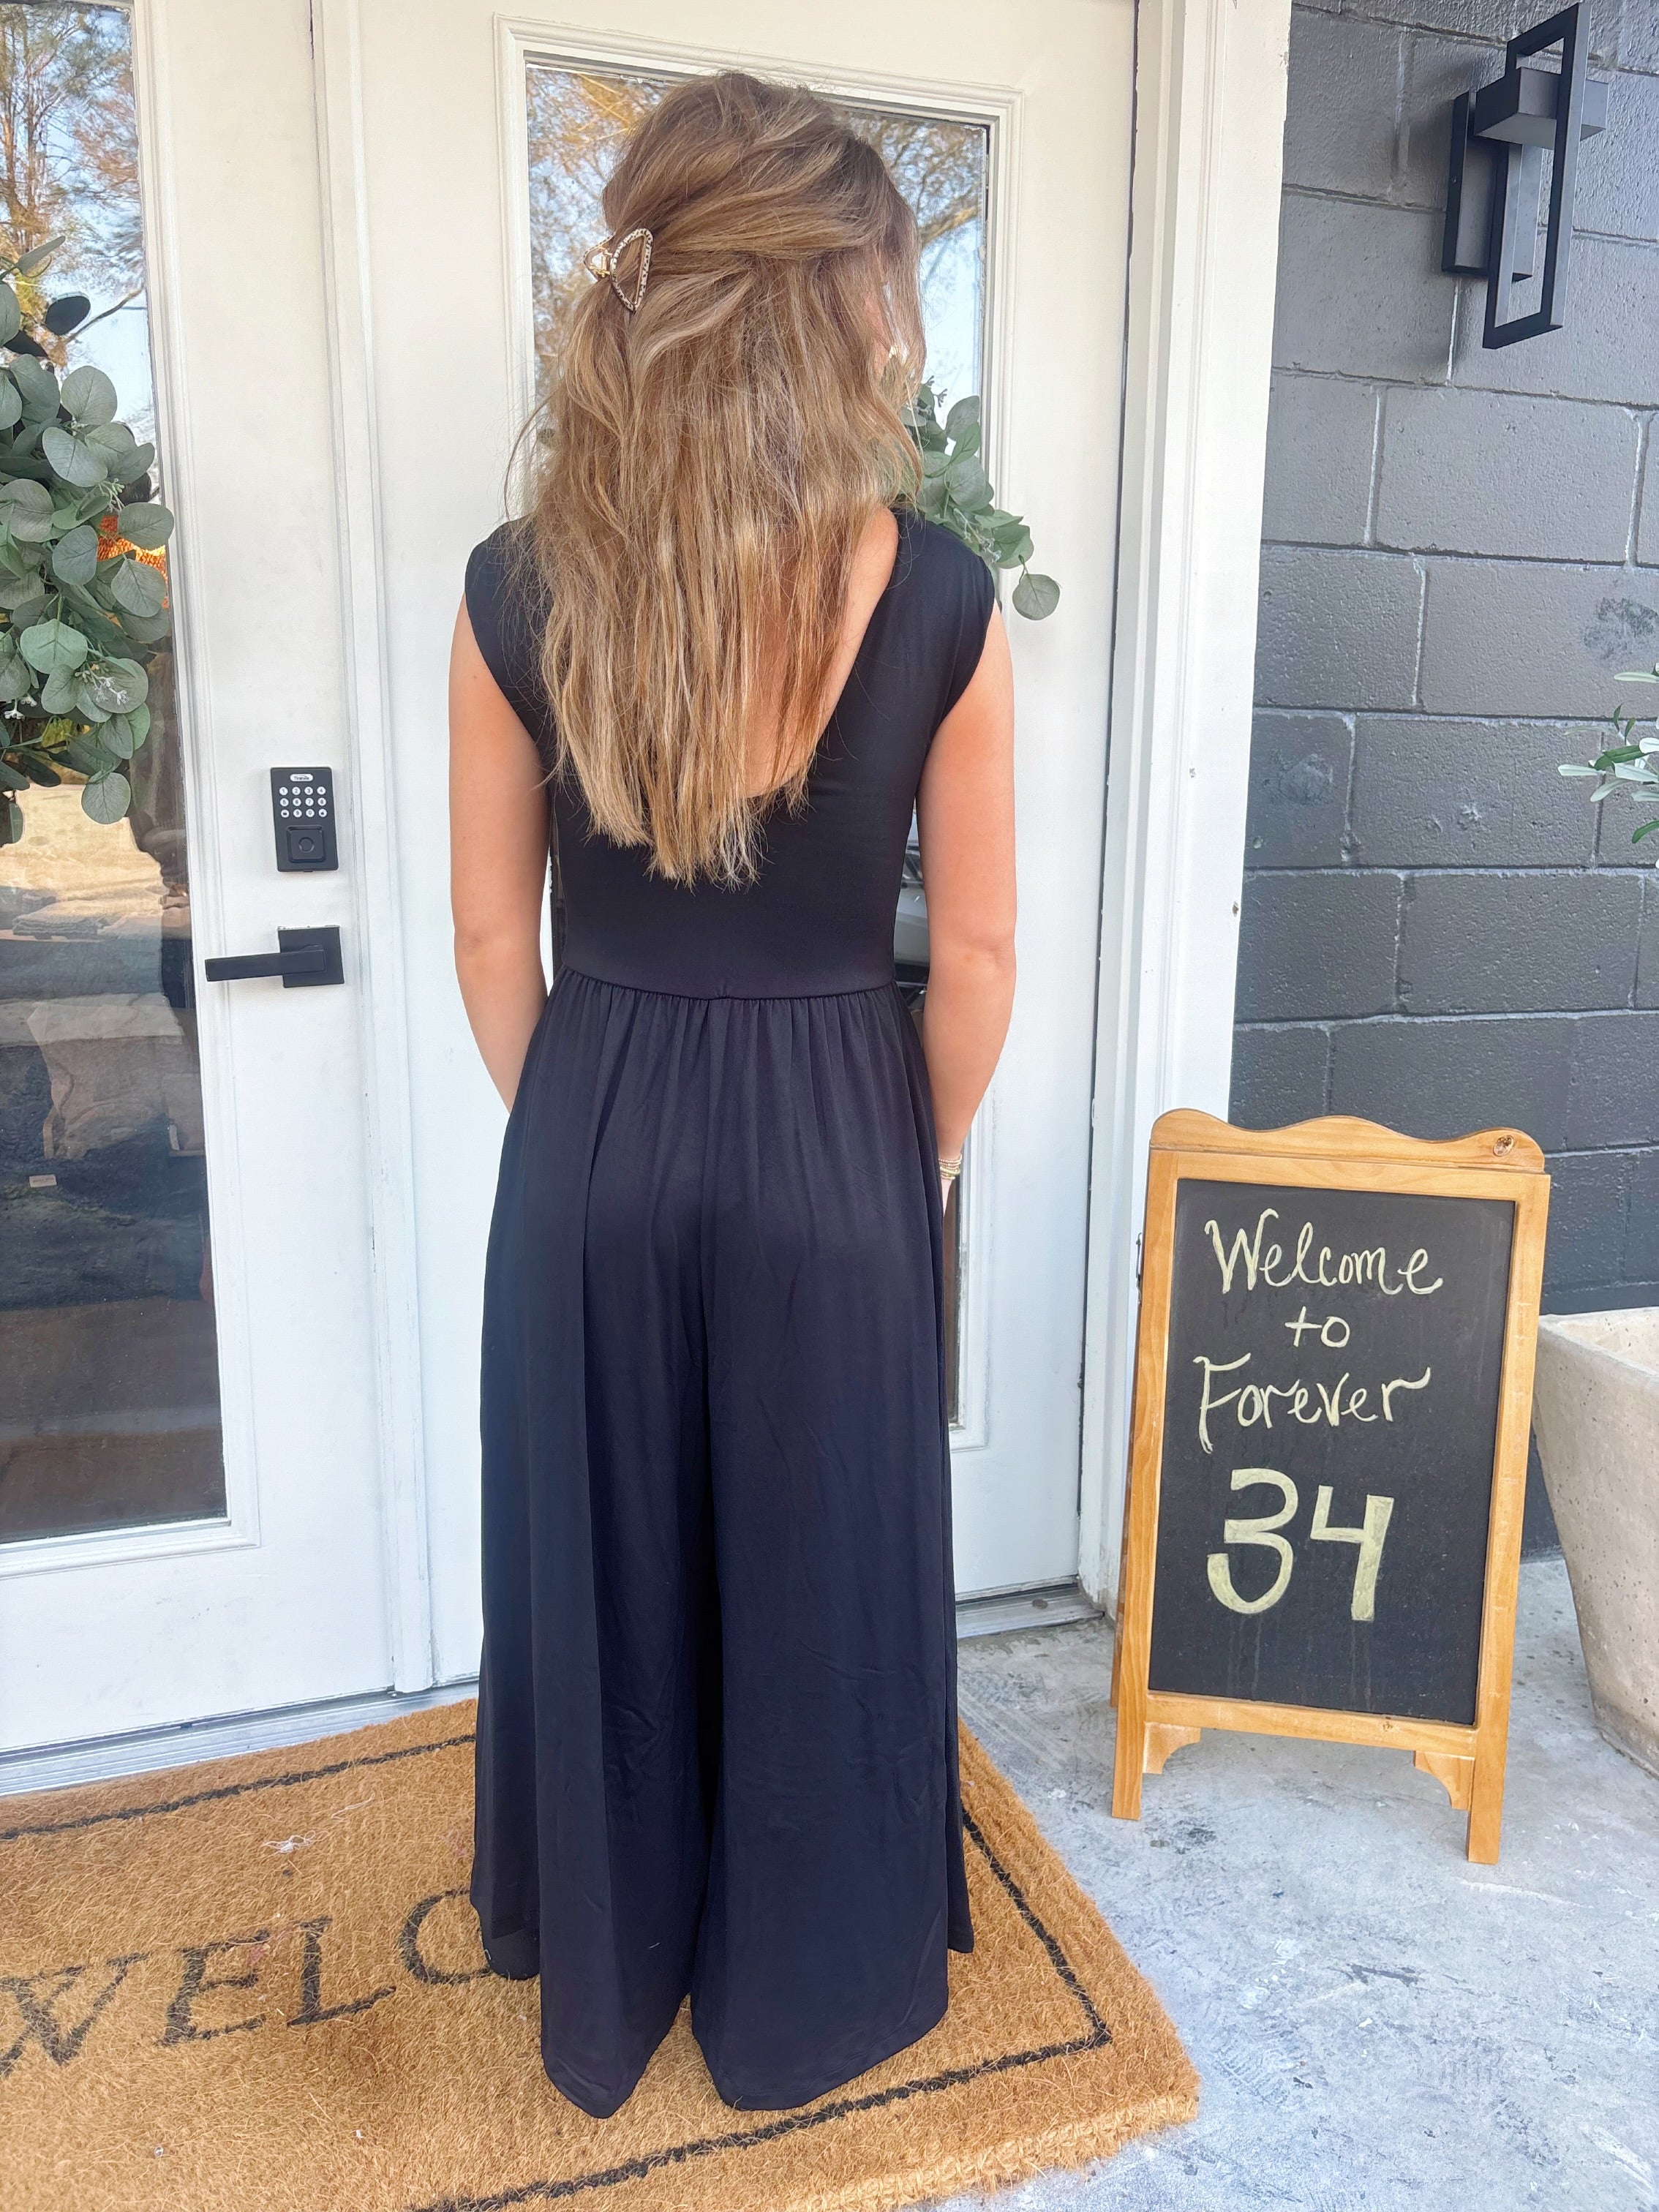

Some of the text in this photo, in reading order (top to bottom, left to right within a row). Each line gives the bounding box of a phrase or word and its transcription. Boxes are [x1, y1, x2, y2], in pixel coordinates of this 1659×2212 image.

[1204, 1208, 1443, 1295] Welcome
[1285, 1306, 1350, 1347] to
[1192, 1353, 1432, 1455] Forever
[1207, 1467, 1394, 1622] 34
